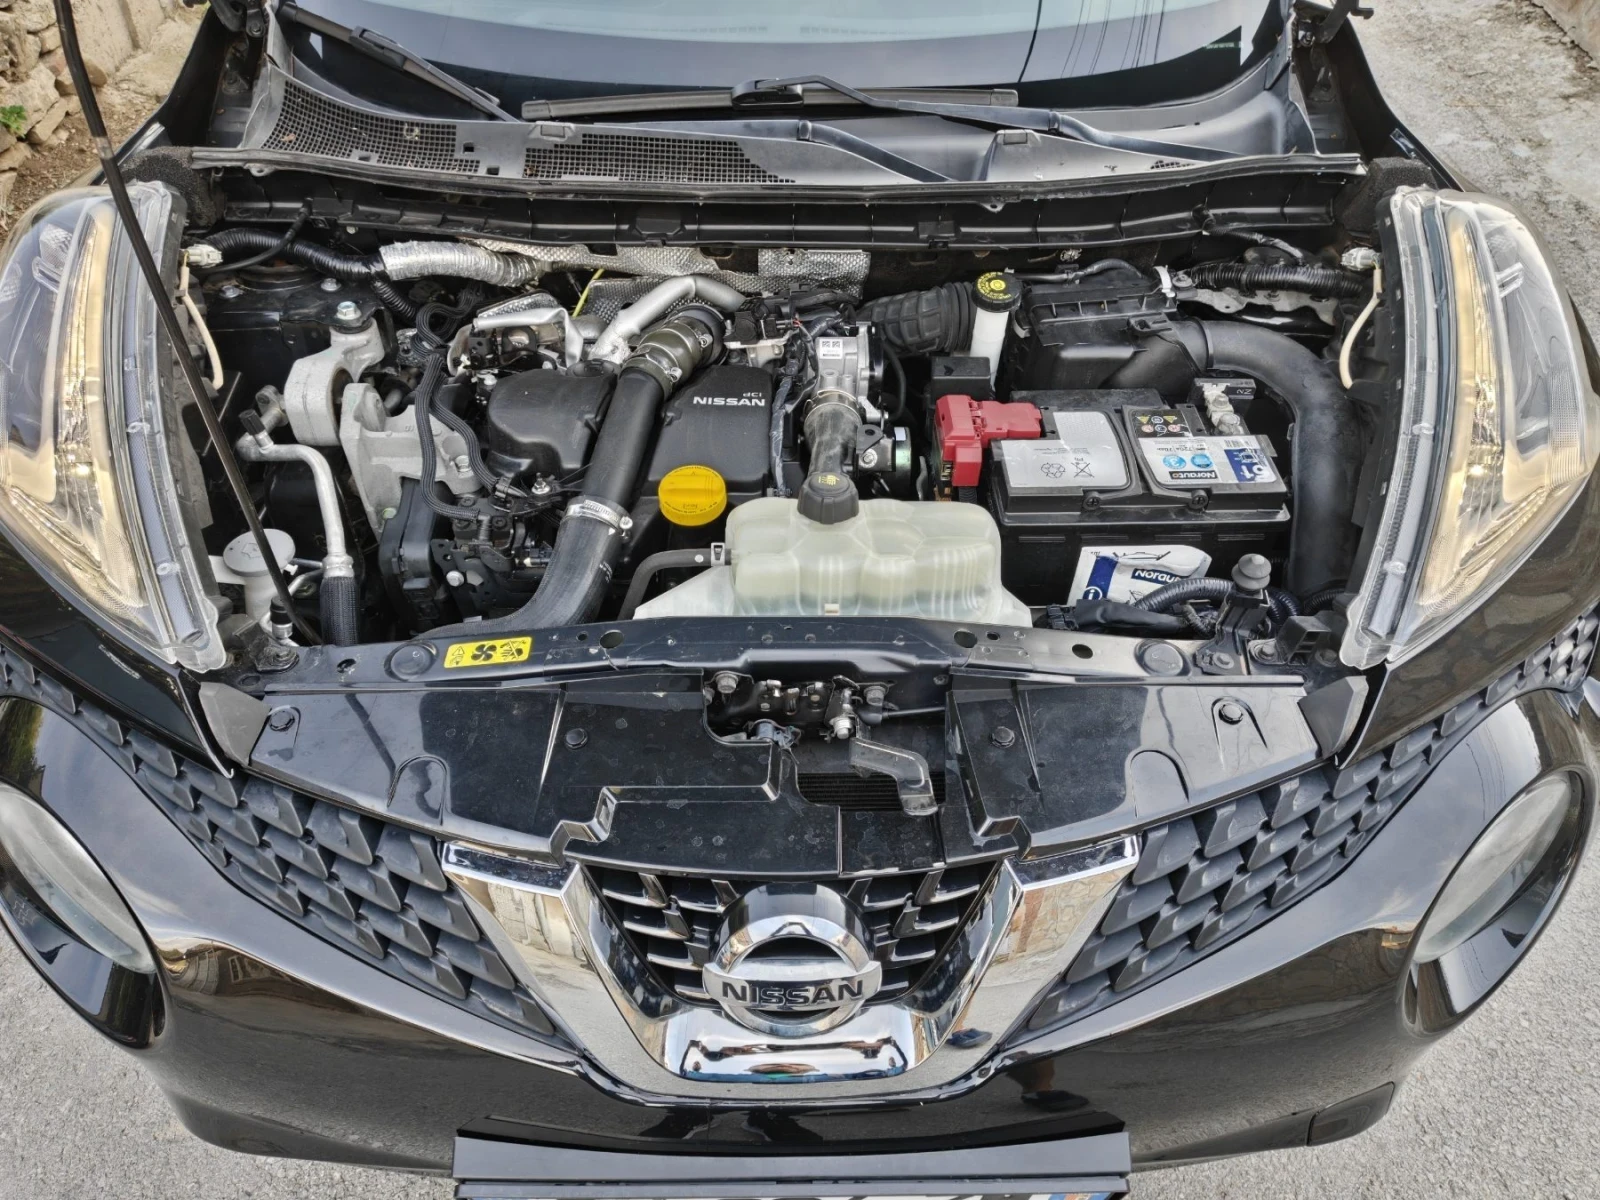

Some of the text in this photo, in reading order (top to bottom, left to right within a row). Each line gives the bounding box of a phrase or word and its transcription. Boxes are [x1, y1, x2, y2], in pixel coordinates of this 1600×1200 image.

[692, 396, 766, 407] NISSAN
[1171, 471, 1216, 479] Norauto
[1134, 569, 1181, 583] Norau
[722, 980, 864, 1006] NISSAN
